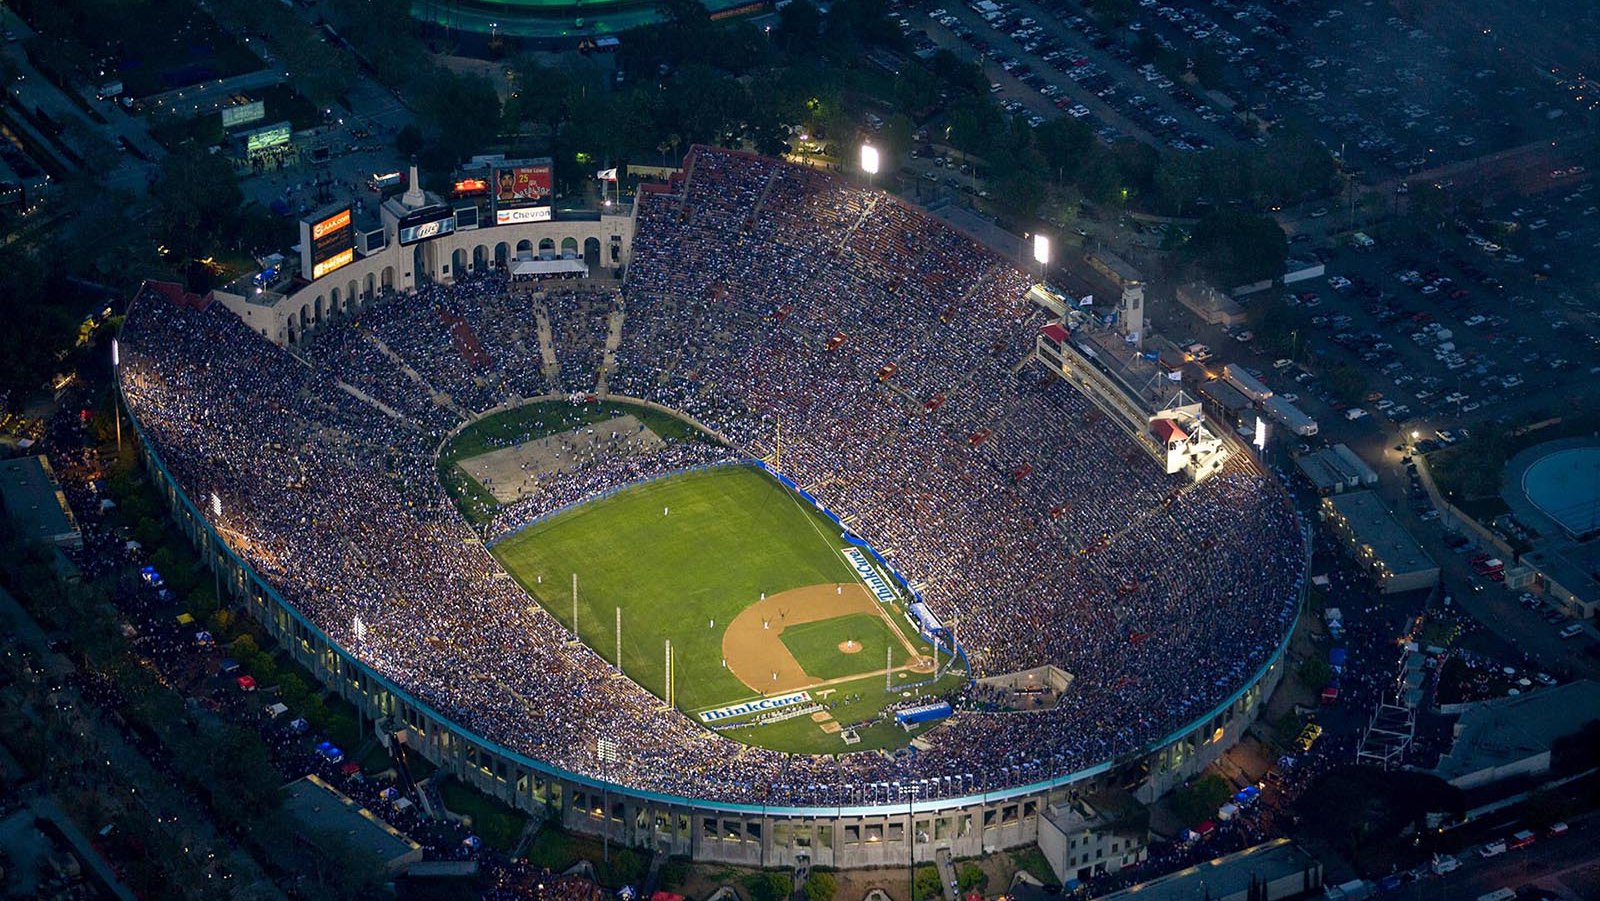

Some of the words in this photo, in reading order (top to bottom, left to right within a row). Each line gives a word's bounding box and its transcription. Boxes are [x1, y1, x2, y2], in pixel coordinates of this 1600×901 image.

[519, 174, 529, 183] 25
[513, 210, 551, 220] Chevron
[843, 548, 894, 601] ThinkCure!
[701, 692, 808, 721] ThinkCure!
